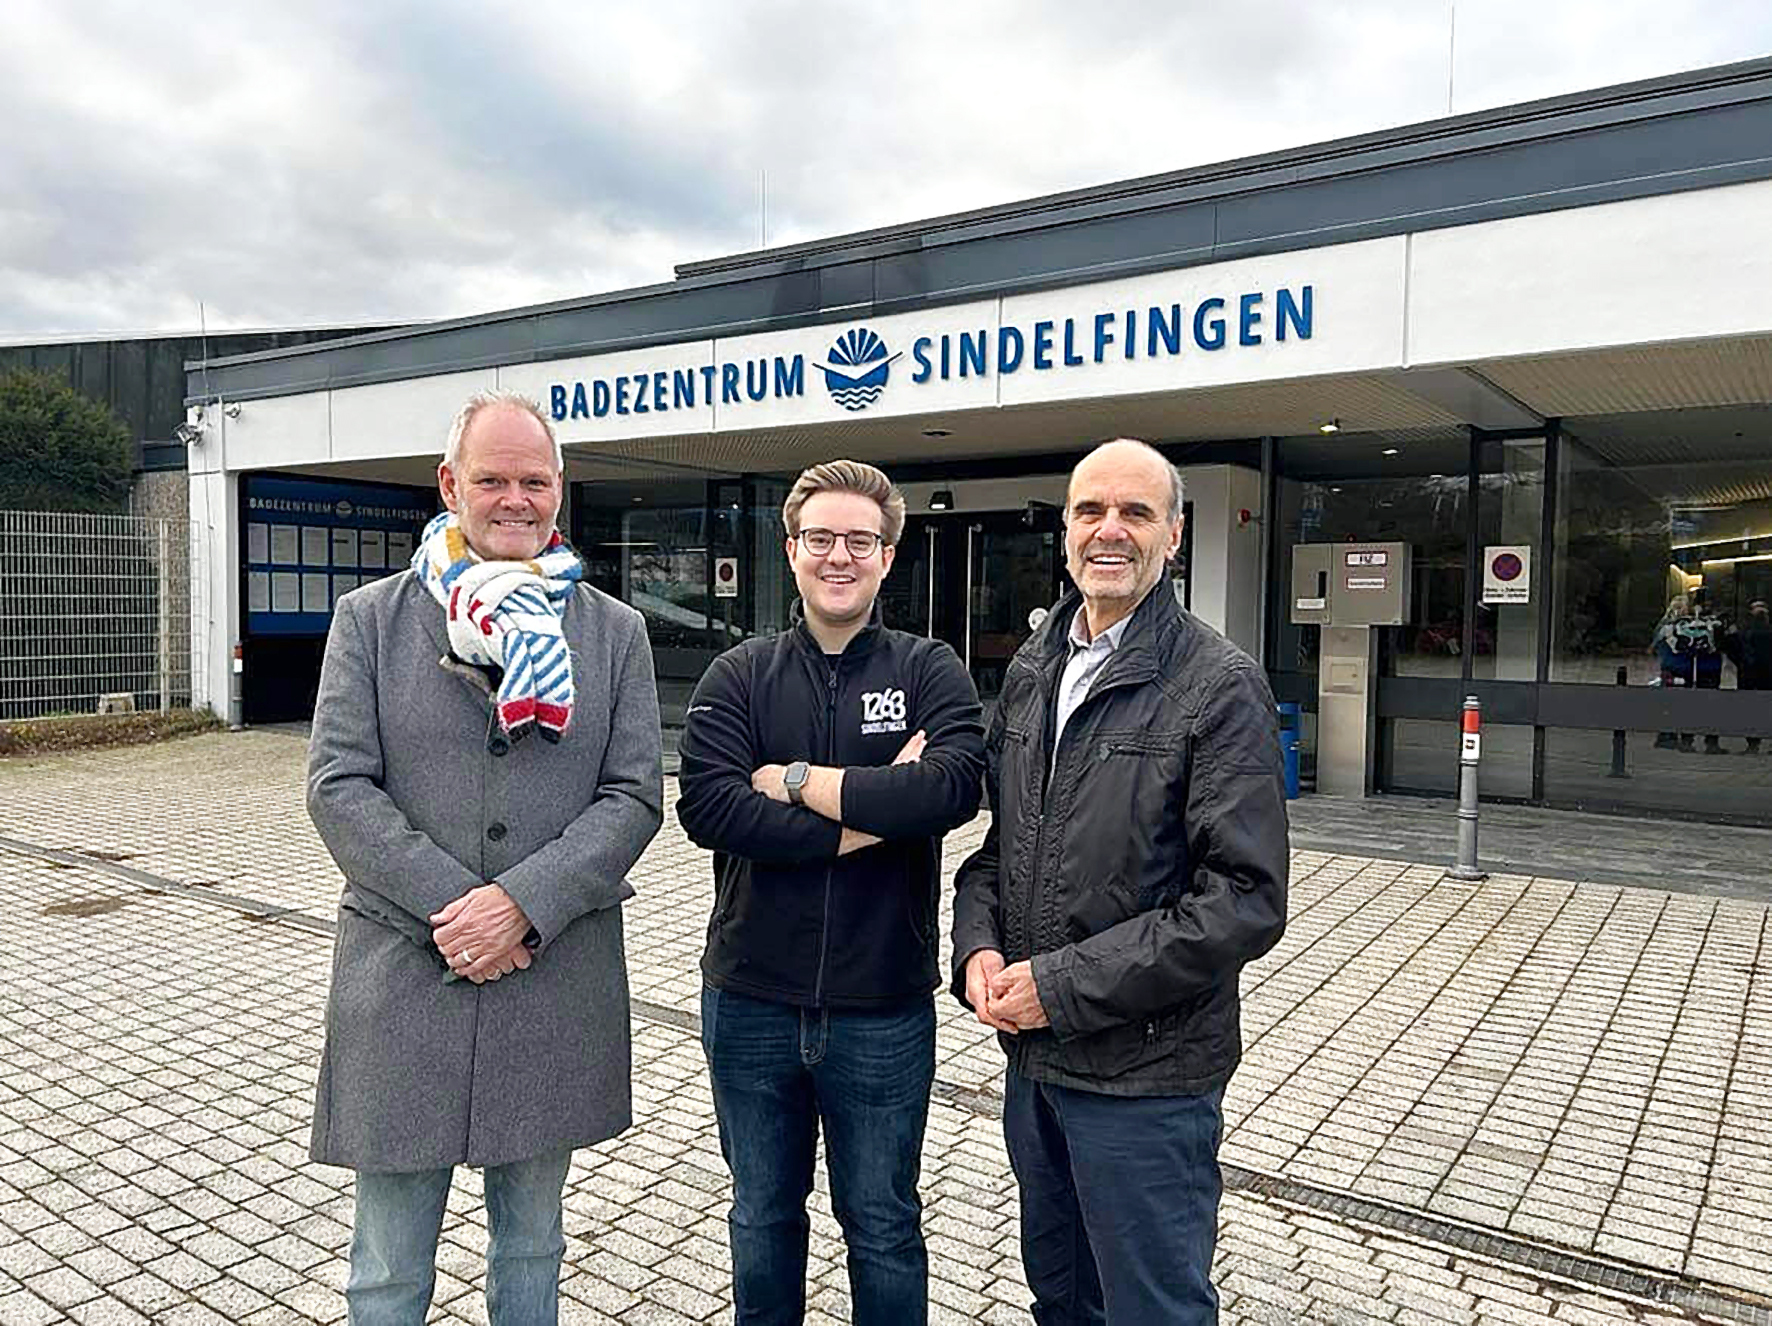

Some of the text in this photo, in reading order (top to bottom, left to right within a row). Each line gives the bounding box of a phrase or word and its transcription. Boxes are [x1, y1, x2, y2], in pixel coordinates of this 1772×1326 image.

[551, 285, 1313, 422] BADEZENTRUM SINDELFINGEN
[250, 497, 331, 513] BADEZENTRUM
[861, 688, 907, 721] 1263
